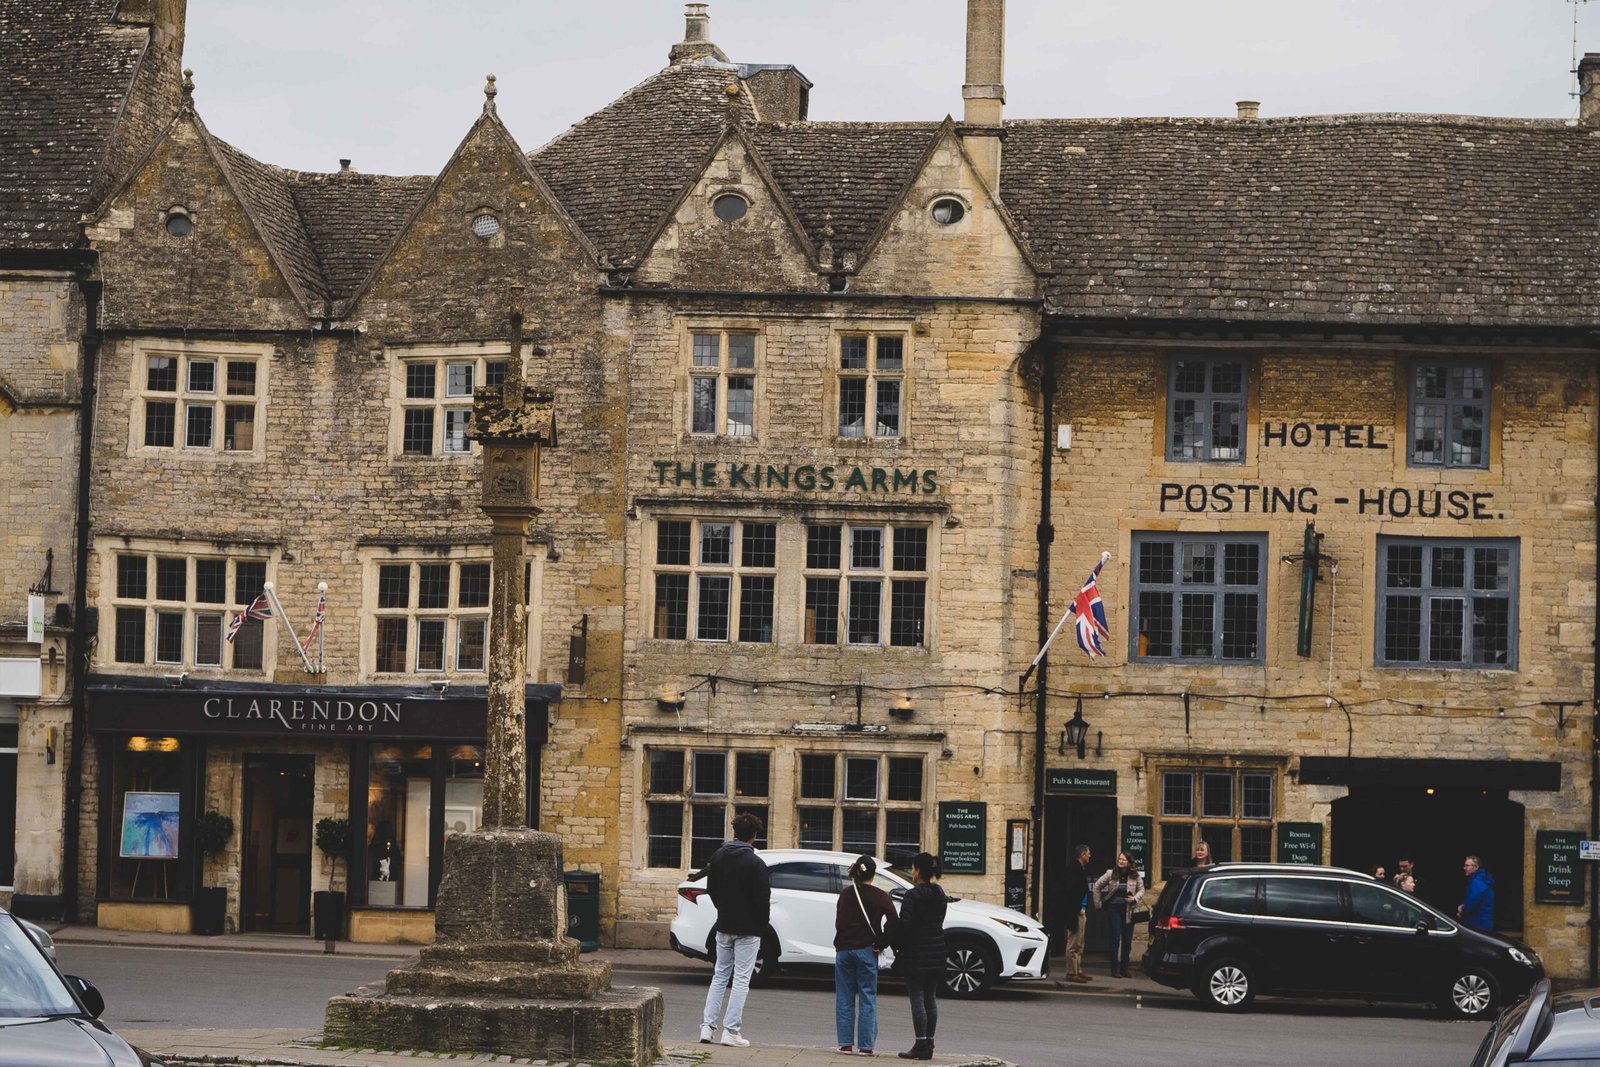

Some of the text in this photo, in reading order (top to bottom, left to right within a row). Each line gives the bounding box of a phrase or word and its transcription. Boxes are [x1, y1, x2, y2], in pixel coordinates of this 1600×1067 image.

[1264, 422, 1388, 449] HOTEL
[653, 460, 937, 494] THE KINGS ARMS
[1160, 482, 1318, 515] POSTING
[203, 698, 403, 729] CLARENDON
[301, 723, 373, 732] FINE ART
[1052, 777, 1066, 785] Pub
[1074, 777, 1110, 786] Restaurant
[1553, 854, 1567, 862] Eat
[1548, 865, 1572, 874] Drink
[1548, 876, 1571, 887] Sleep
